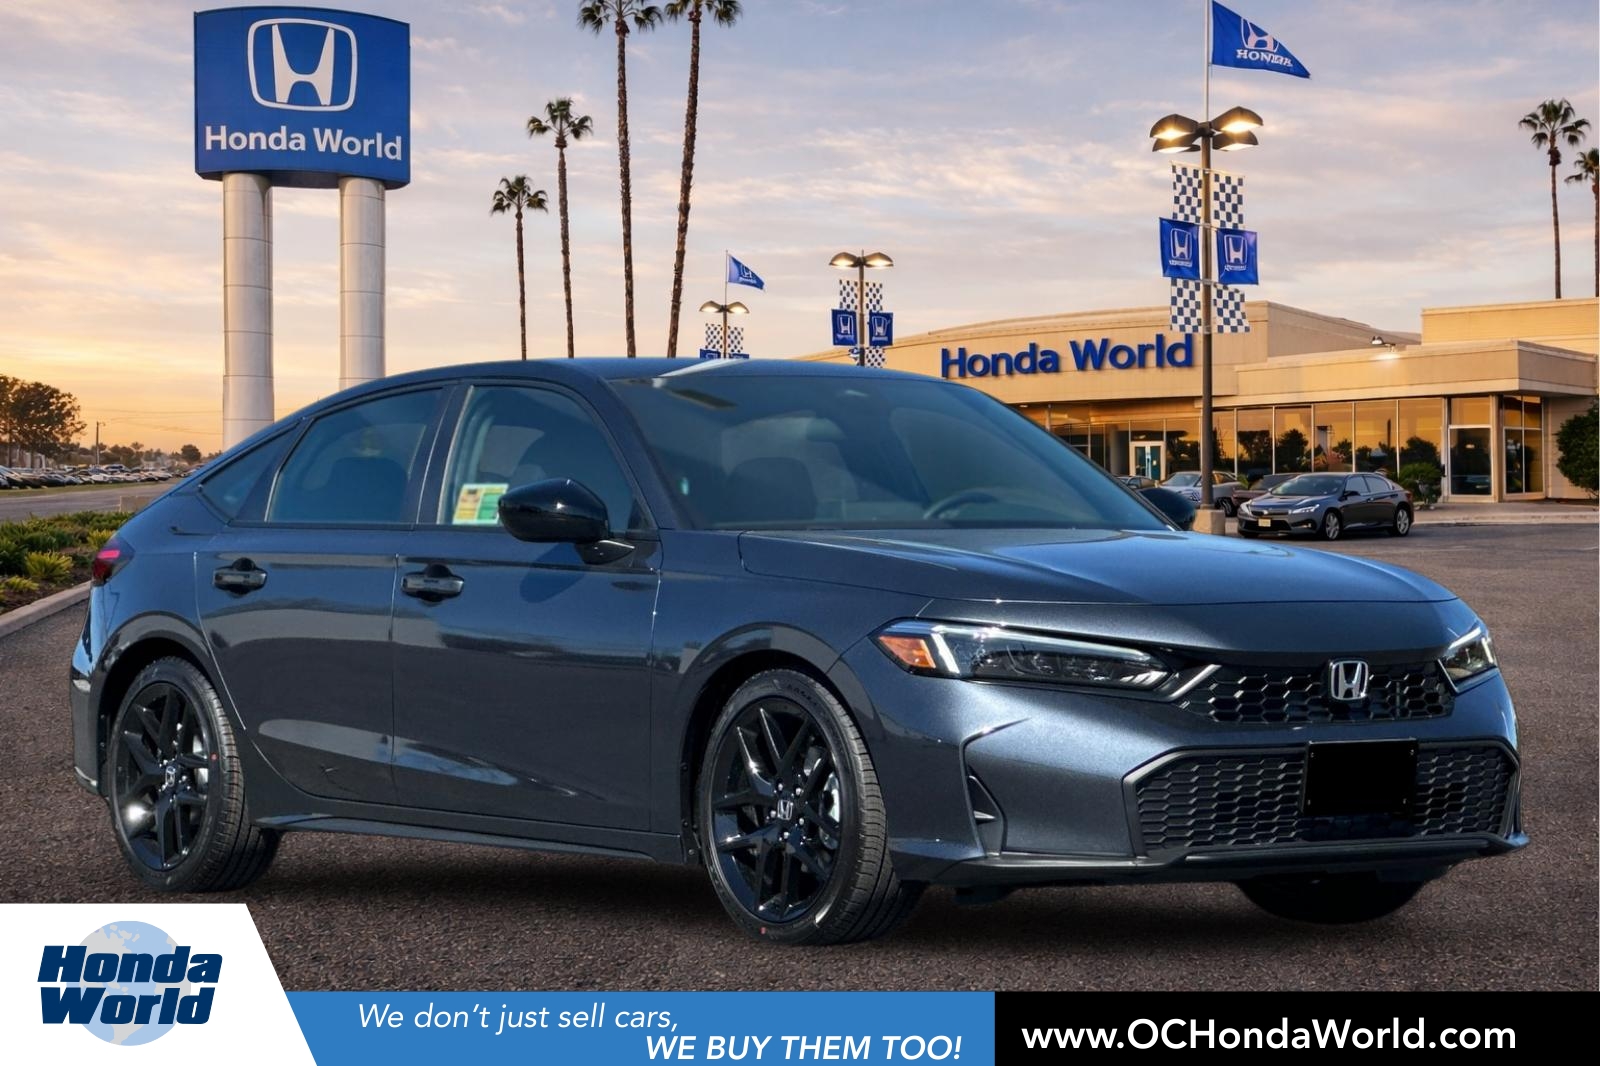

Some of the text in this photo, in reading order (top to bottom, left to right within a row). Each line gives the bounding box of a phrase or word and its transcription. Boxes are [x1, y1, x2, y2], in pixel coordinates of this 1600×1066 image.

[205, 125, 402, 161] Honda World
[941, 333, 1193, 378] Honda World
